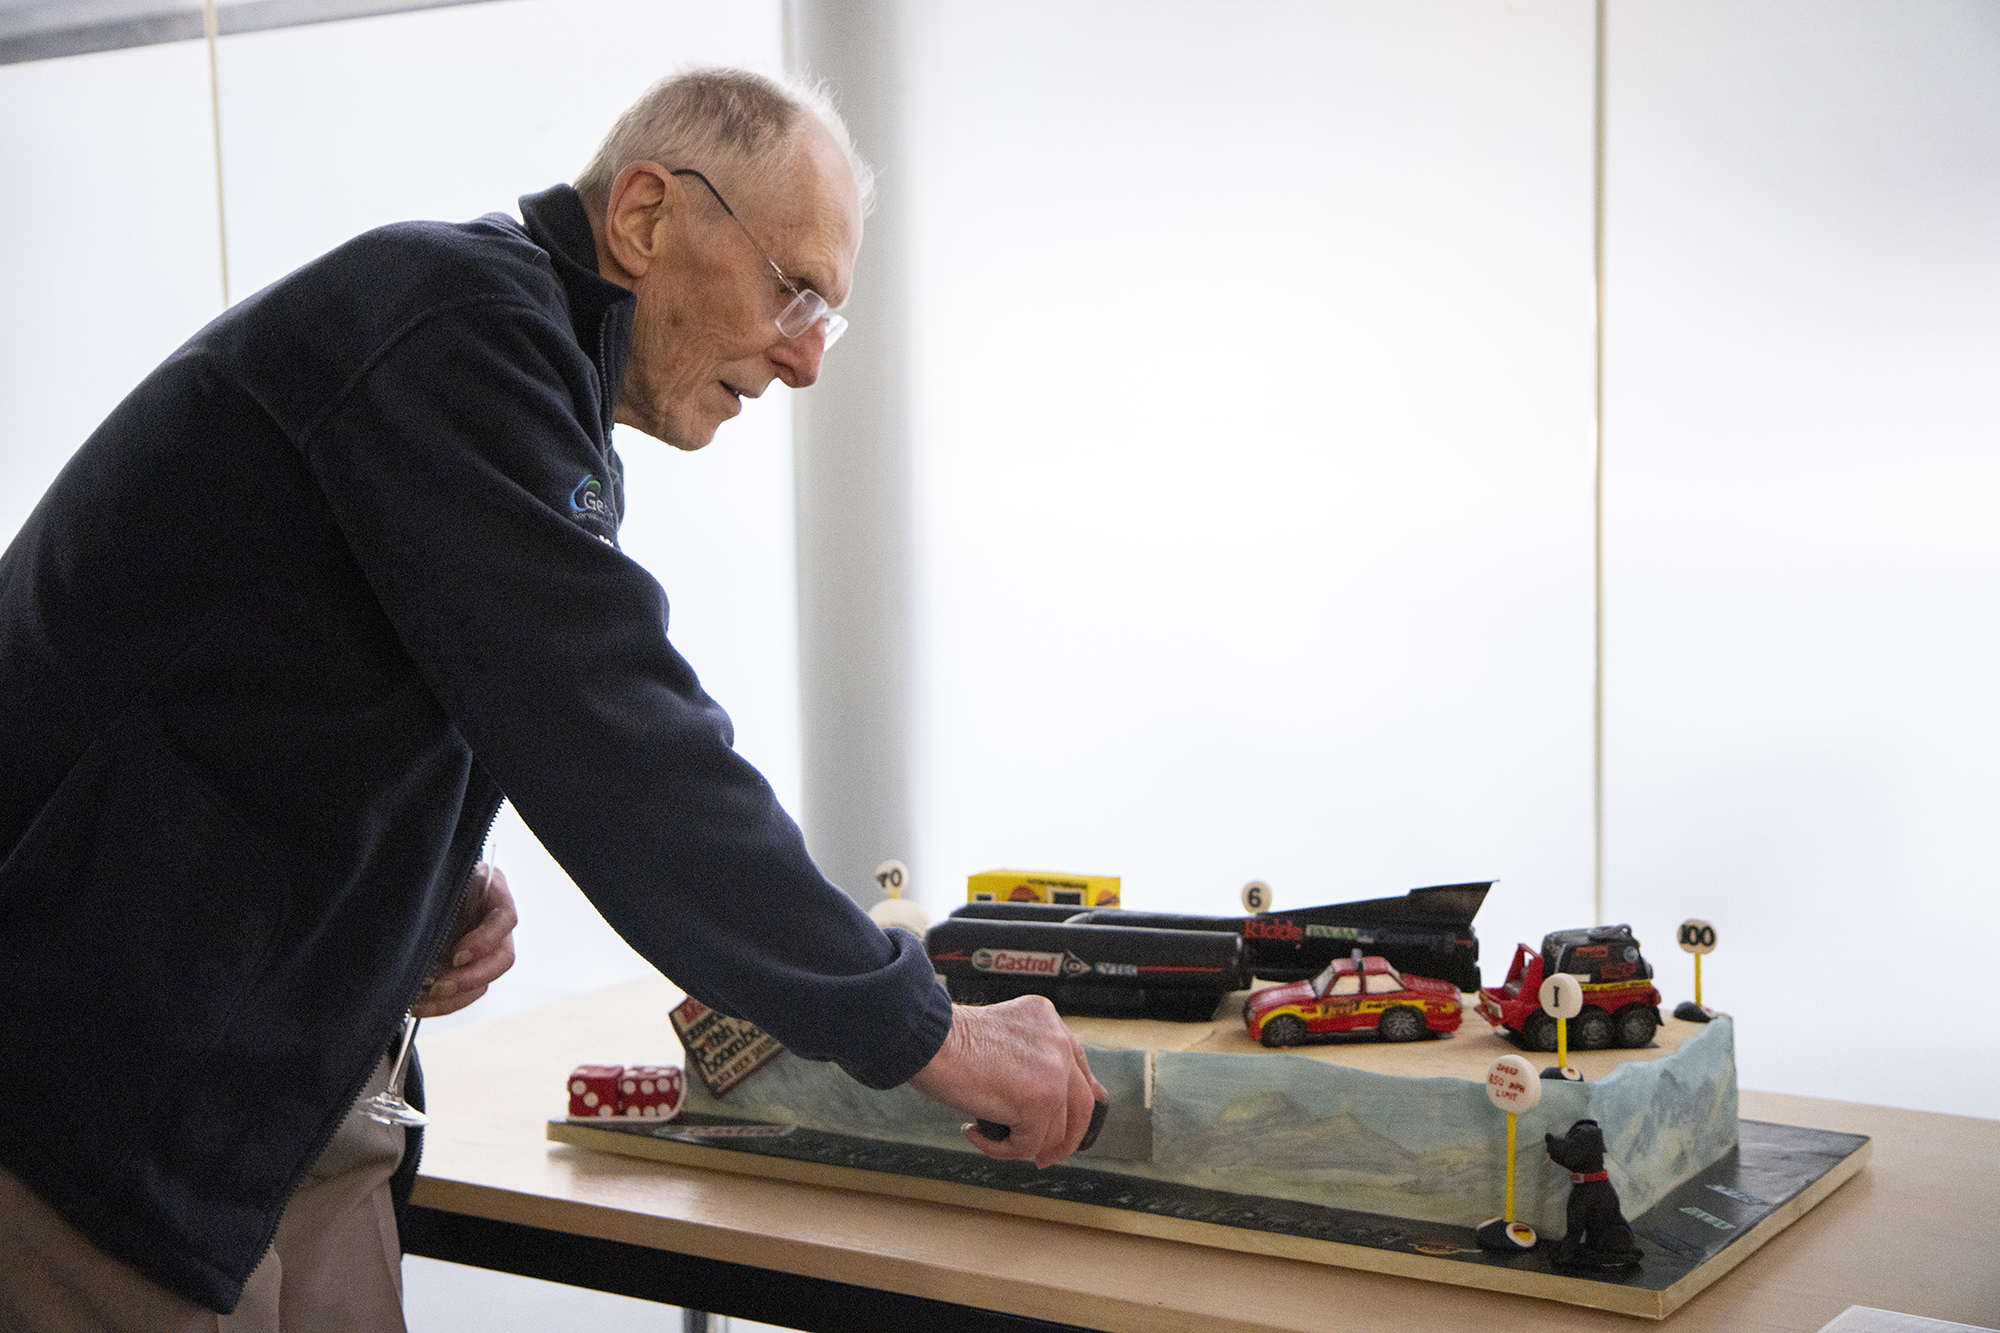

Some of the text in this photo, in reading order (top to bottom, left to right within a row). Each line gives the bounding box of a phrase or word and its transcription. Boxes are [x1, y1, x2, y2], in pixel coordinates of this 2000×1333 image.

[876, 867, 903, 888] 70
[1247, 887, 1261, 908] 6
[1681, 923, 1715, 946] 100
[995, 953, 1055, 973] Castrol
[1496, 1063, 1518, 1075] SPEED
[1495, 1089, 1518, 1102] LIMIT
